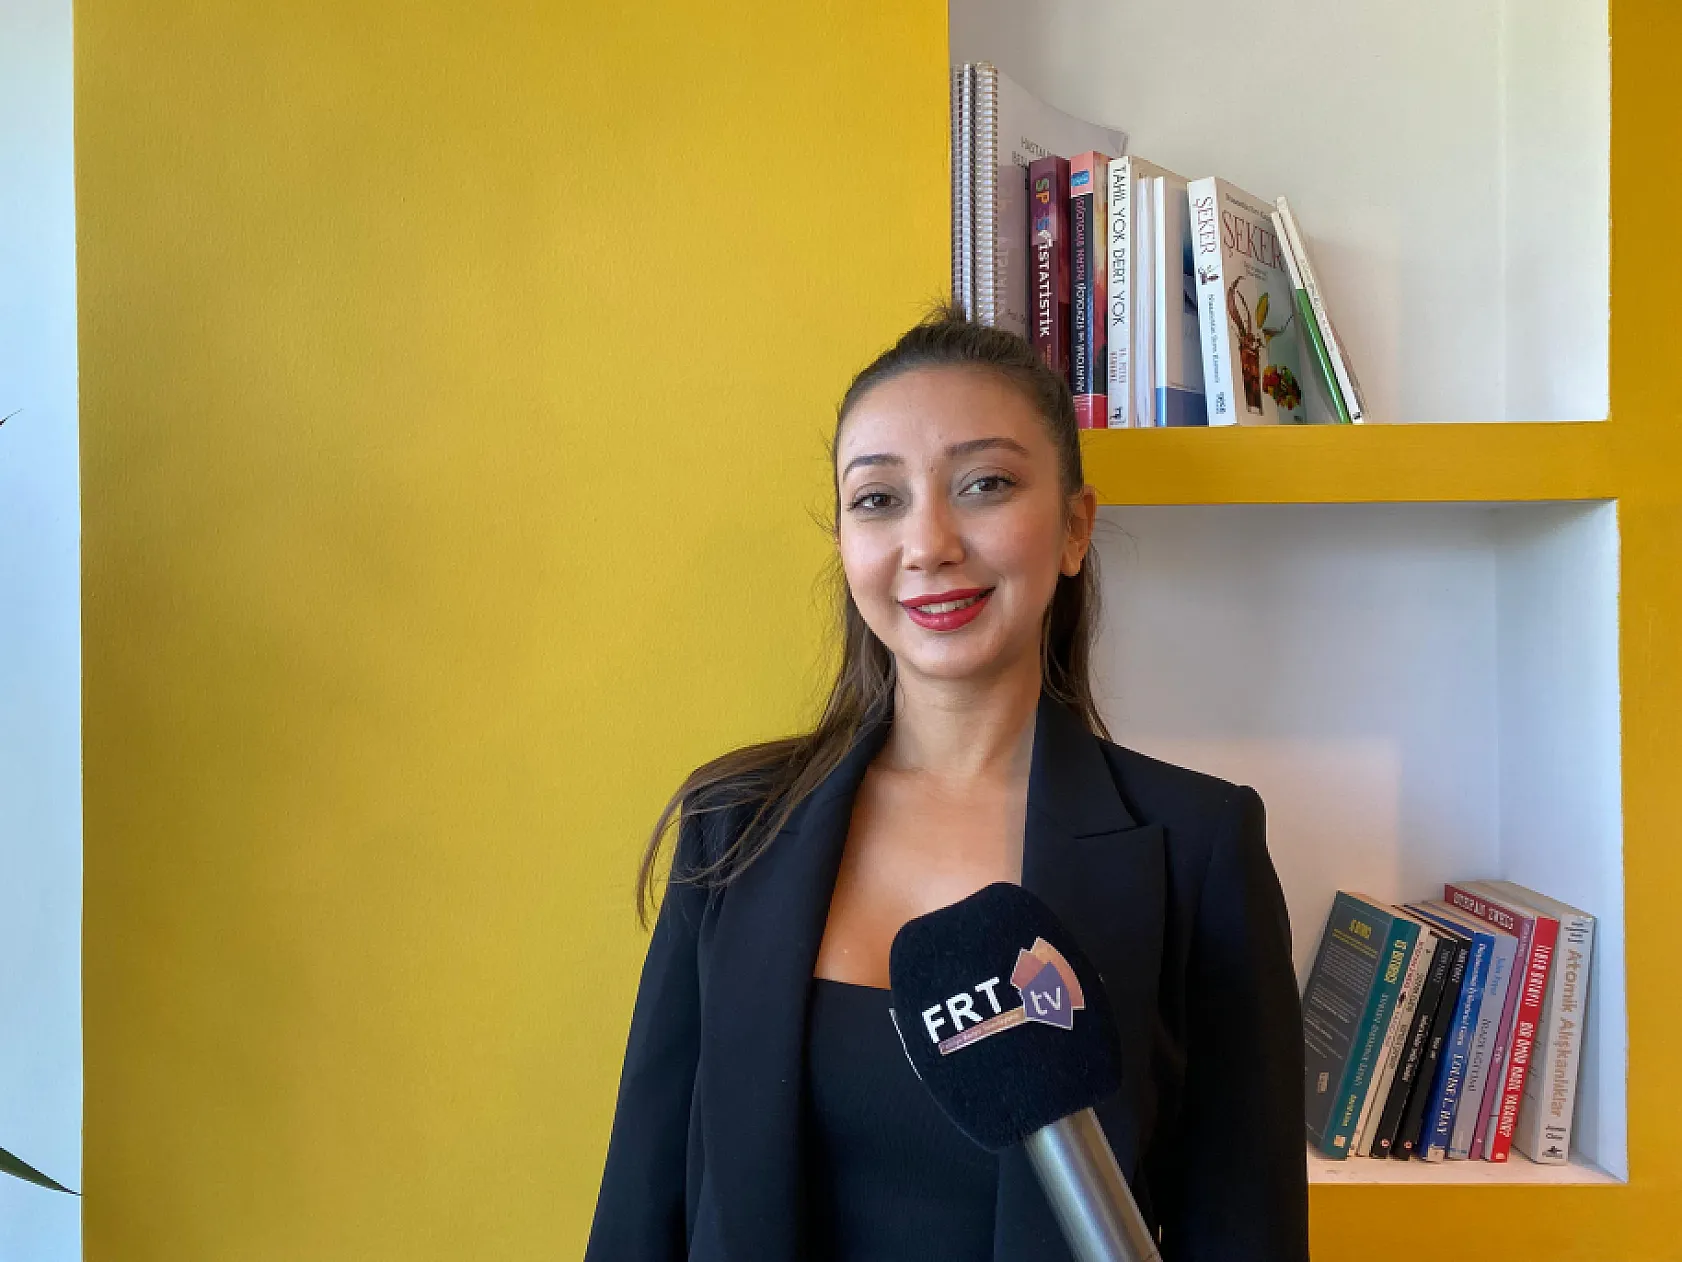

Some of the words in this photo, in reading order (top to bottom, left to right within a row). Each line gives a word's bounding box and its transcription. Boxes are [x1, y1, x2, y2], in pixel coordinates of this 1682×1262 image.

[1112, 165, 1127, 207] TAHIL
[1112, 208, 1127, 243] YOK
[1193, 196, 1216, 254] ŞEKER
[1221, 209, 1285, 273] ŞEKER
[1112, 248, 1126, 284] DERT
[1111, 290, 1125, 327] YOK
[1563, 949, 1583, 1018] Atomik
[922, 976, 1002, 1044] FRT
[1030, 986, 1061, 1016] tv
[1445, 1053, 1464, 1097] LOUISE
[1436, 1112, 1451, 1135] HAY
